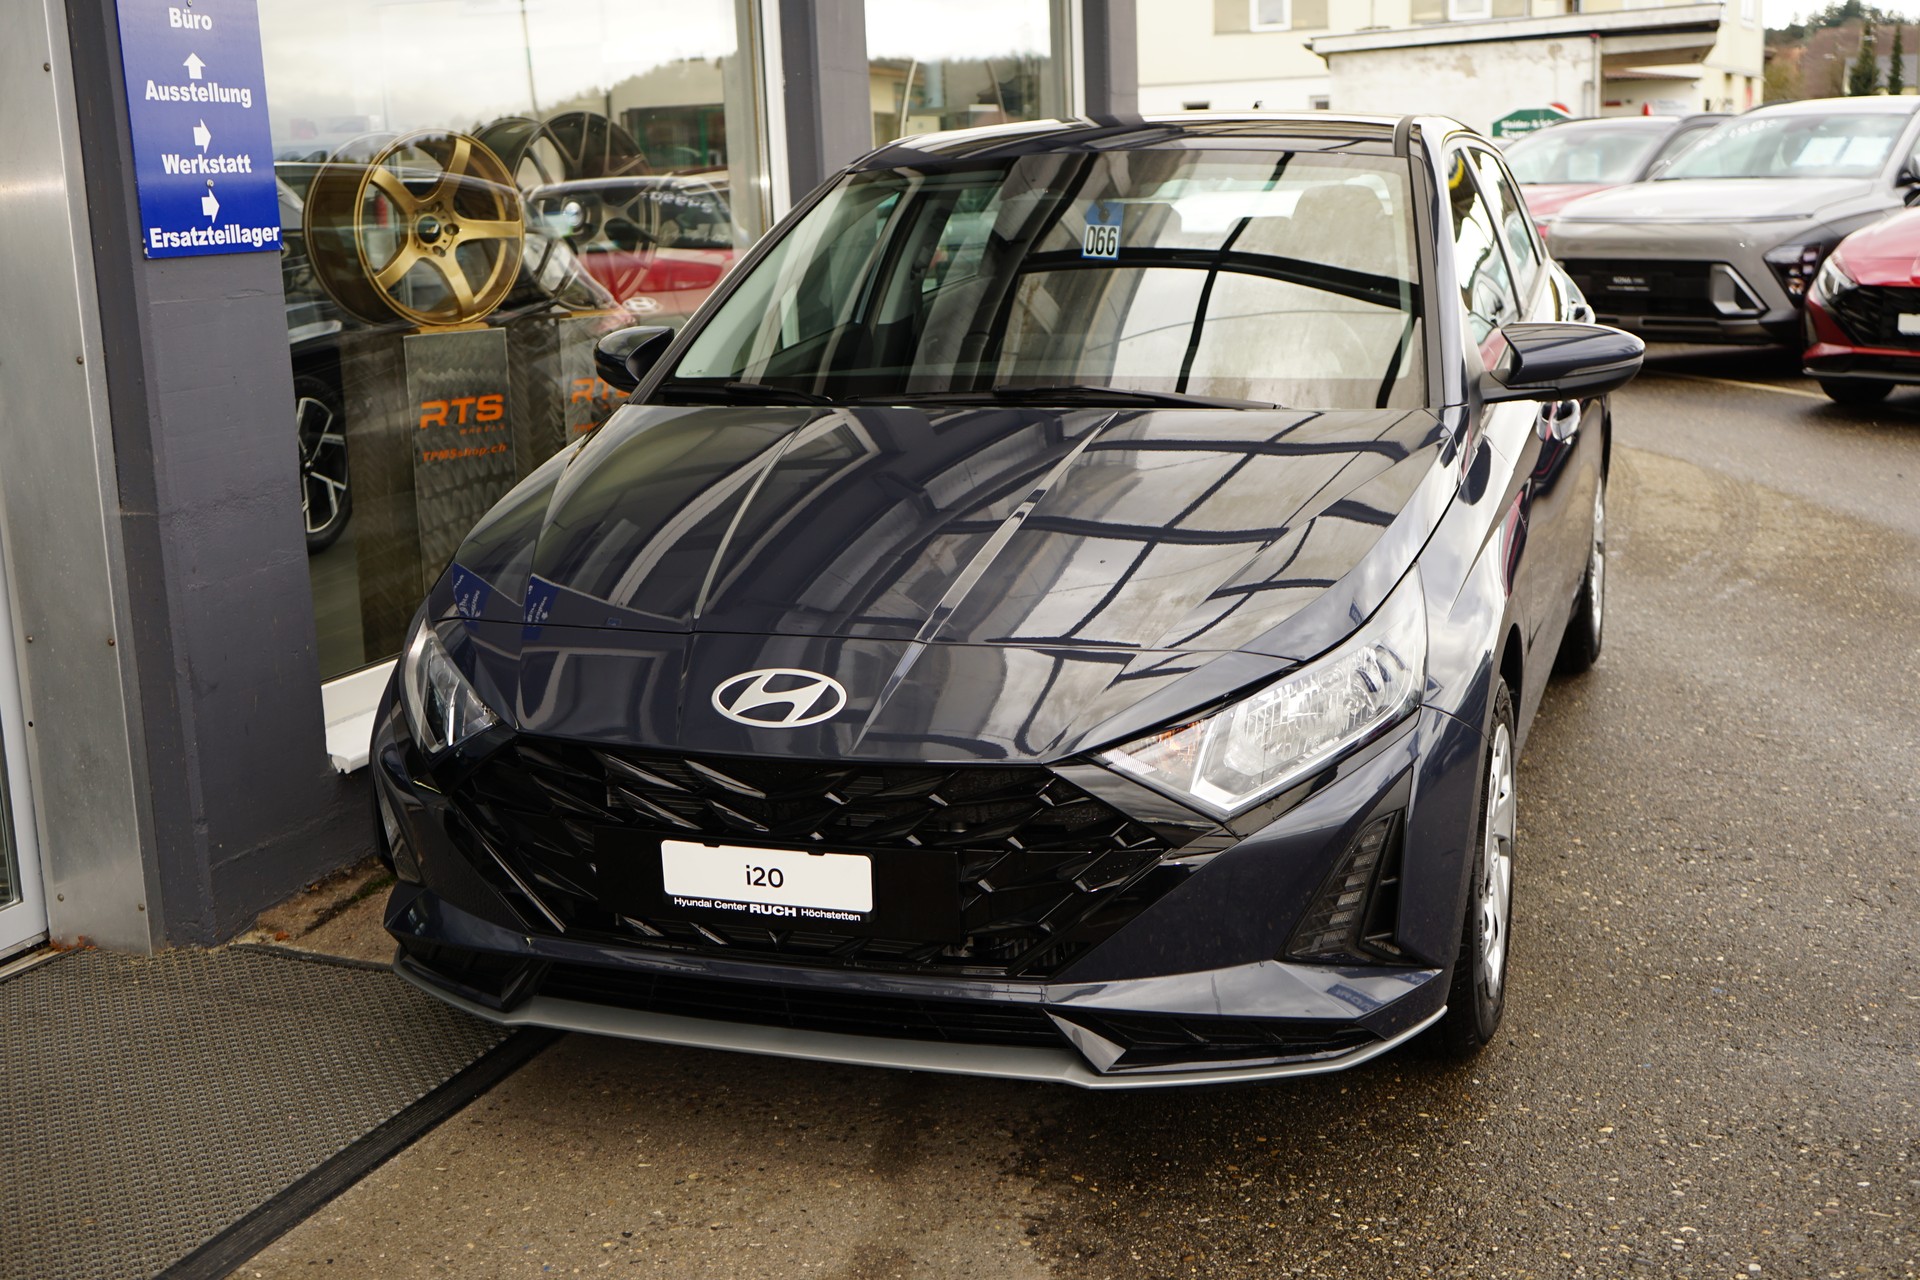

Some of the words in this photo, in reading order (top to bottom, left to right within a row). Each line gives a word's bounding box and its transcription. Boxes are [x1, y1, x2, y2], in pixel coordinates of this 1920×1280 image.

[168, 7, 213, 30] Büro
[145, 79, 252, 108] Ausstellung
[161, 154, 252, 175] Werkstatt
[149, 224, 280, 248] Ersatzteillager
[1085, 226, 1117, 256] 066
[571, 377, 630, 404] RT
[419, 393, 504, 429] RTS
[745, 865, 784, 888] i20
[674, 896, 712, 909] Hyundai
[714, 900, 747, 912] Center
[749, 903, 797, 917] RUCH
[801, 908, 861, 922] Höchstetten
